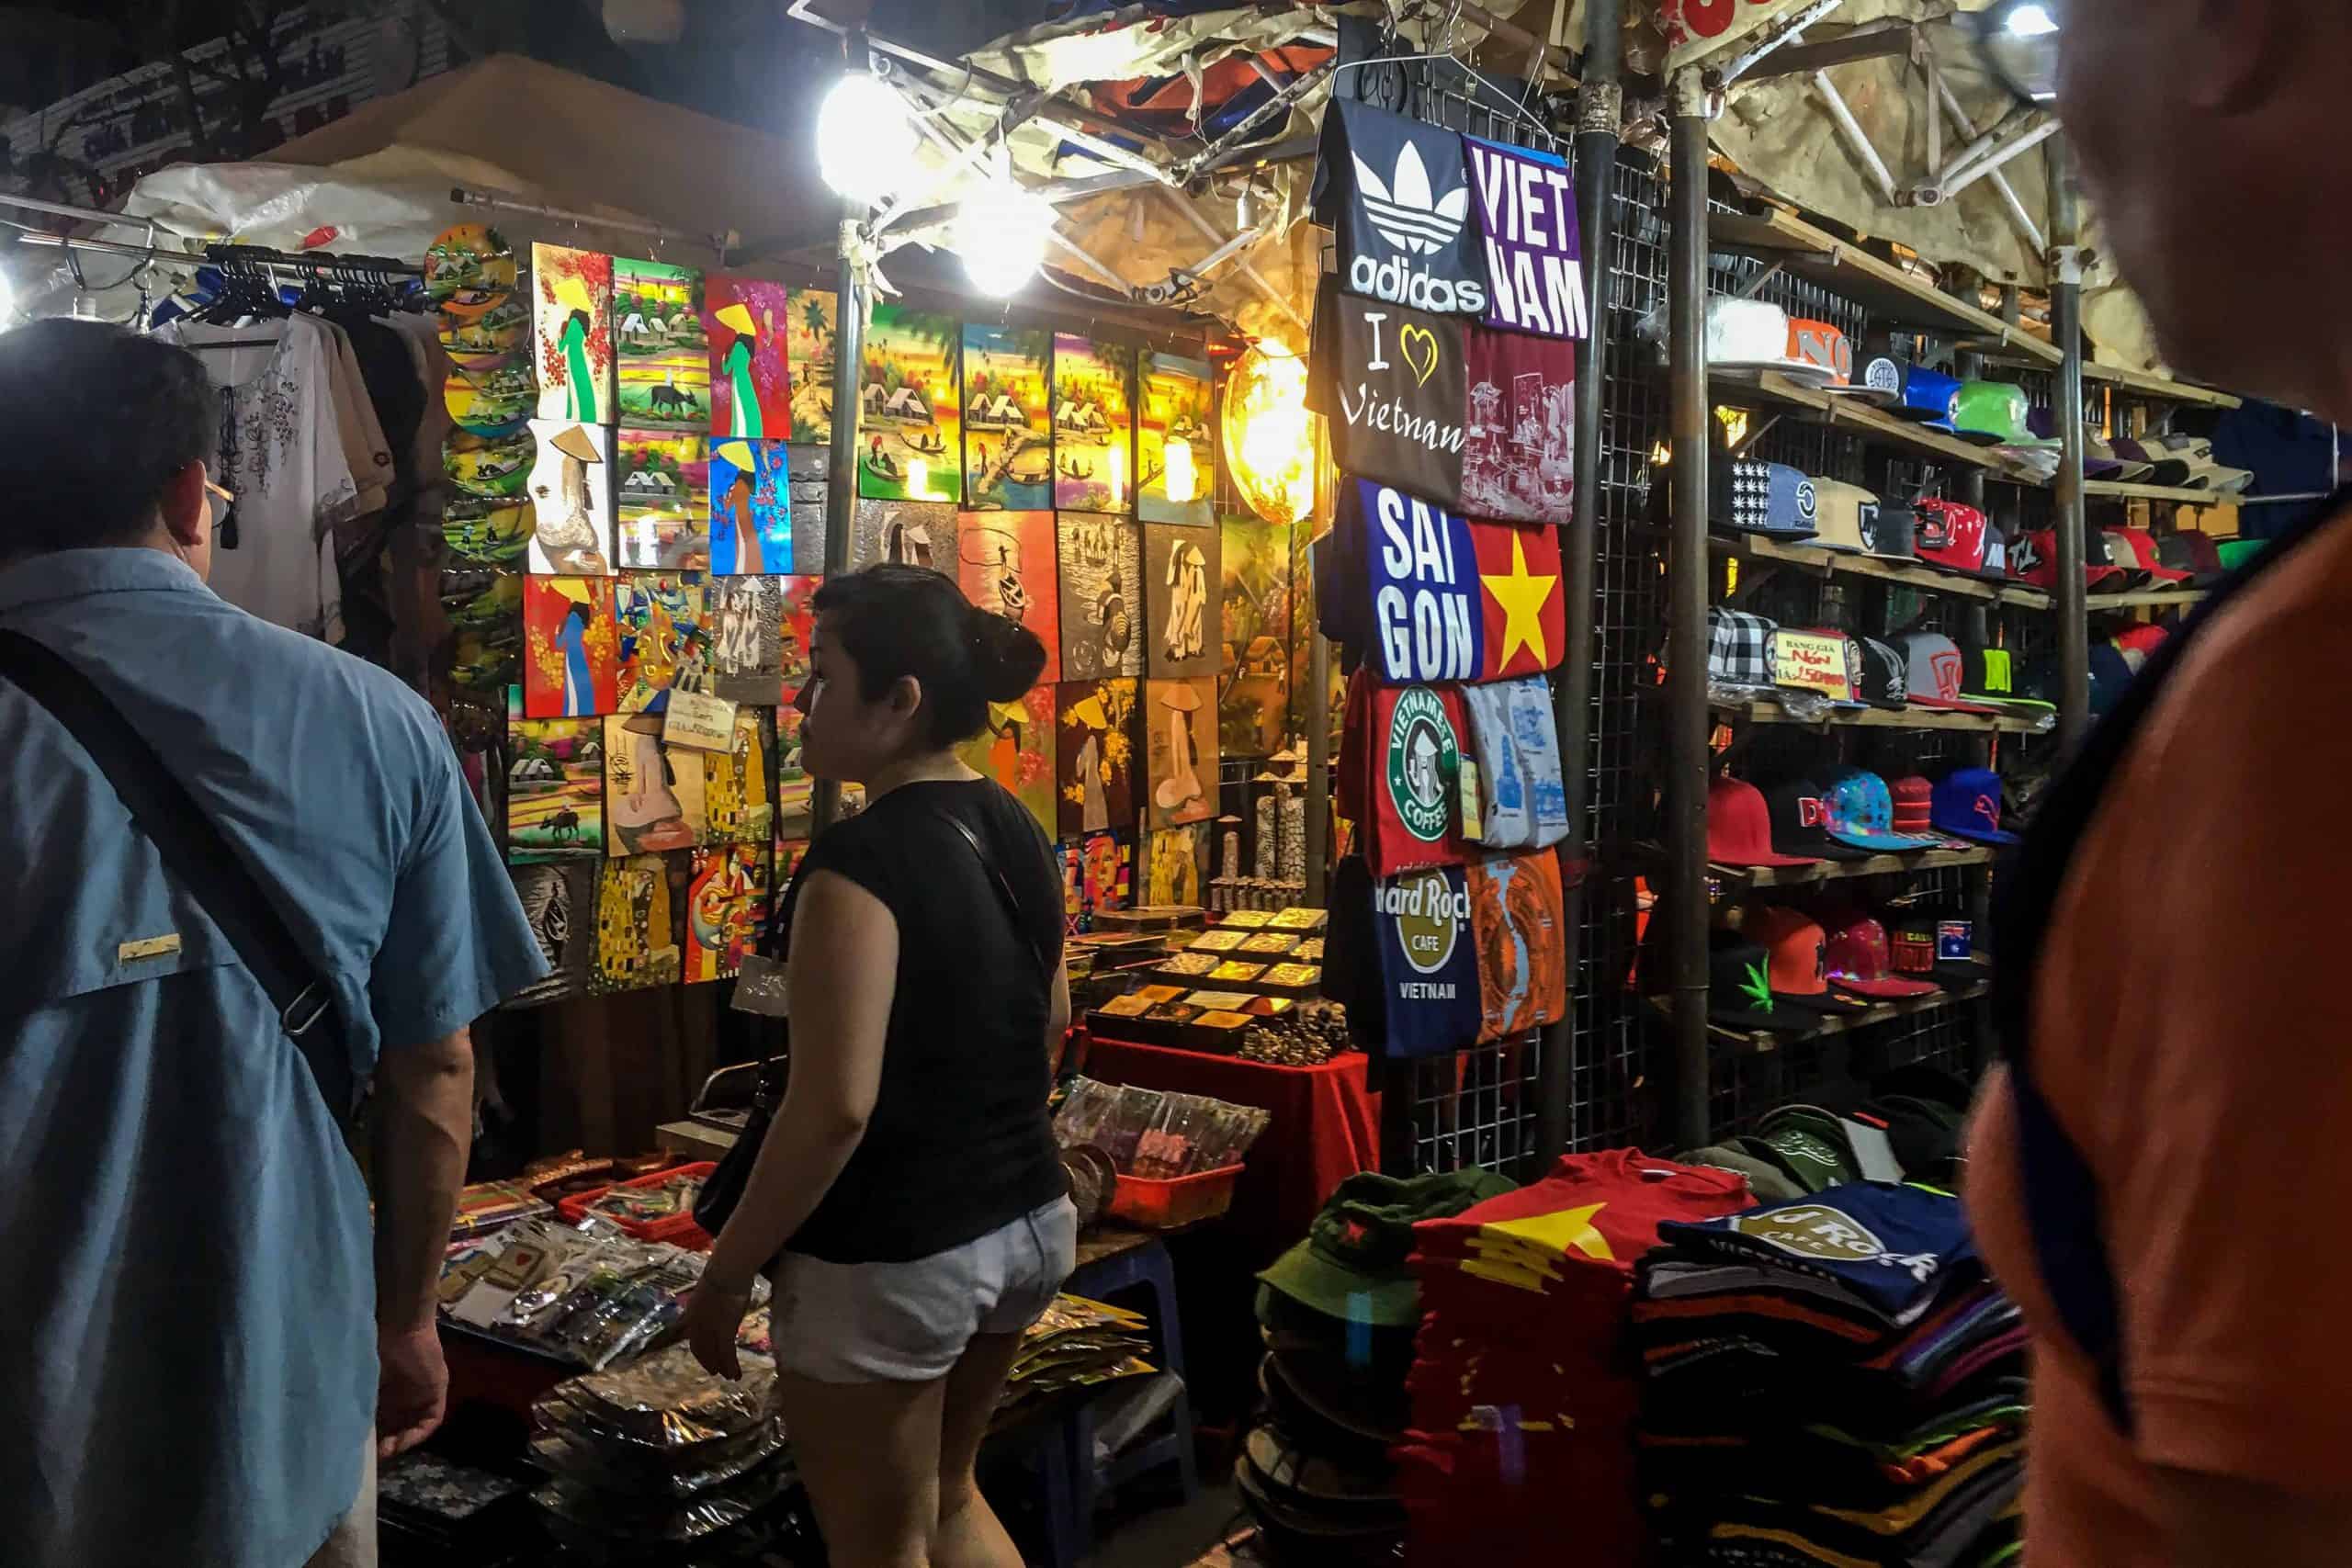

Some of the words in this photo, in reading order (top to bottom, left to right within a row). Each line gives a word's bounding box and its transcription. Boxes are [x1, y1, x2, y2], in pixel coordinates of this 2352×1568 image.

[1472, 146, 1569, 253] VIET
[1350, 254, 1487, 313] adidas
[1485, 235, 1589, 339] NAM
[1364, 312, 1390, 371] I
[1378, 487, 1456, 585] SAI
[1378, 585, 1474, 682] GON
[1391, 692, 1453, 754] VIETNAMESE
[1411, 934, 1440, 952] CAFE
[1399, 982, 1456, 999] VIETNAM
